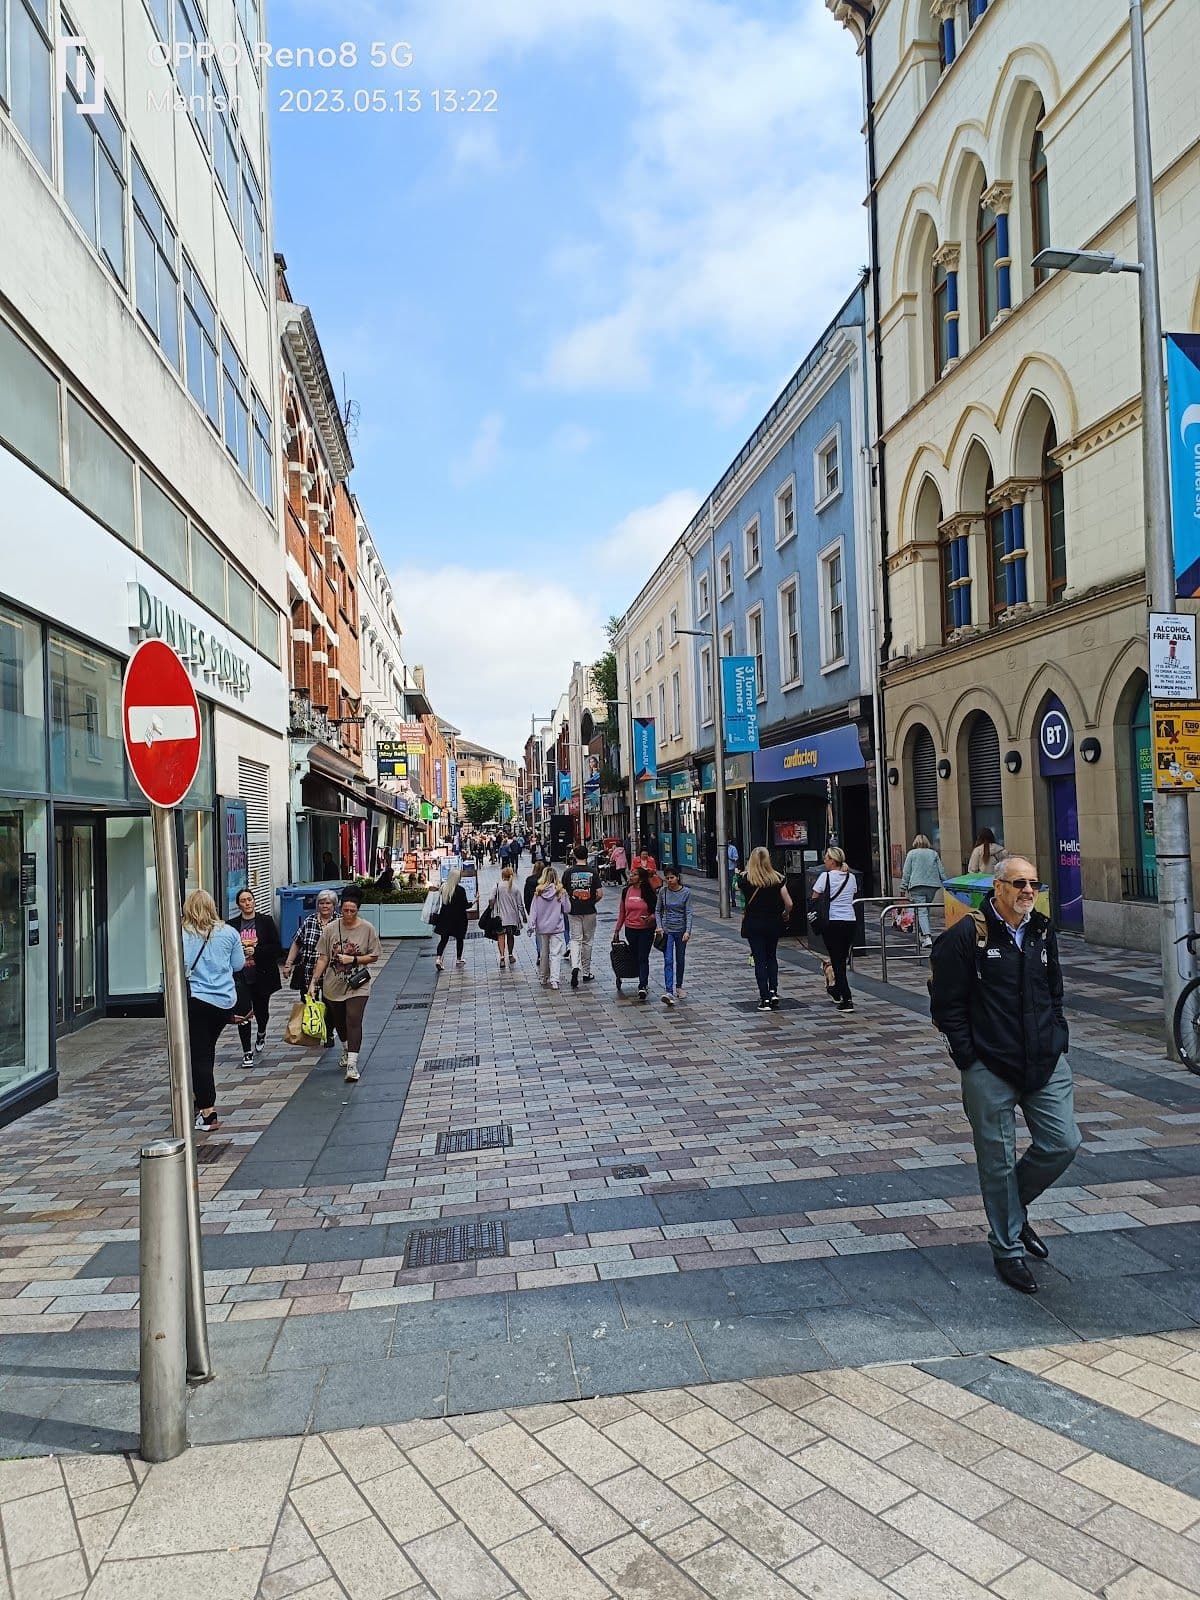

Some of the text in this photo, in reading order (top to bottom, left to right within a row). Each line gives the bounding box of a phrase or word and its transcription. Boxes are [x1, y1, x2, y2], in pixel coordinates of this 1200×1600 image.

[136, 583, 251, 692] DUNNES STORES
[1155, 625, 1190, 634] ALCOHOL
[1172, 633, 1192, 641] AREA
[735, 666, 745, 714] Winners
[745, 666, 758, 742] 3 Turner Prize
[1046, 725, 1062, 745] BT
[377, 742, 390, 750] To
[392, 742, 406, 750] Let
